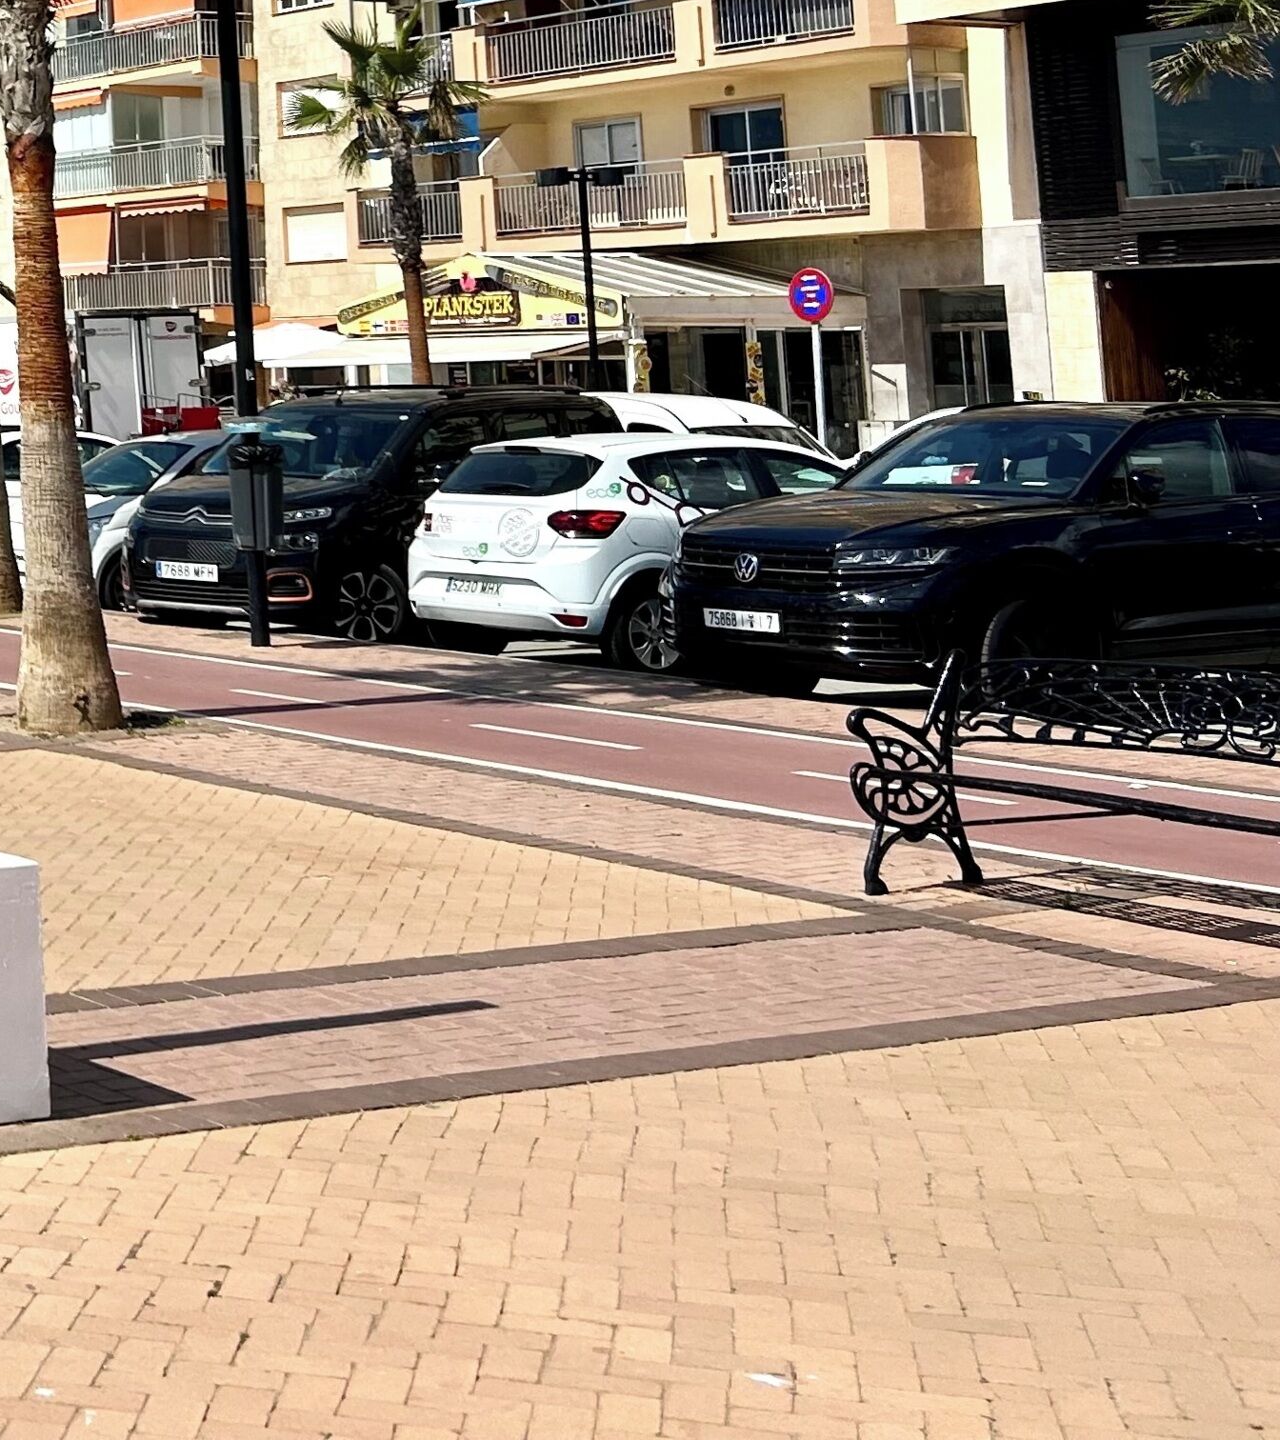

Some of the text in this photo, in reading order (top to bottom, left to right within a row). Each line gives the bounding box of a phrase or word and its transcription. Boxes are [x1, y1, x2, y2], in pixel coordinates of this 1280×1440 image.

[422, 294, 514, 317] PLANKSTEK
[164, 564, 190, 577] 7688
[451, 580, 477, 593] 5230
[766, 615, 773, 629] 7
